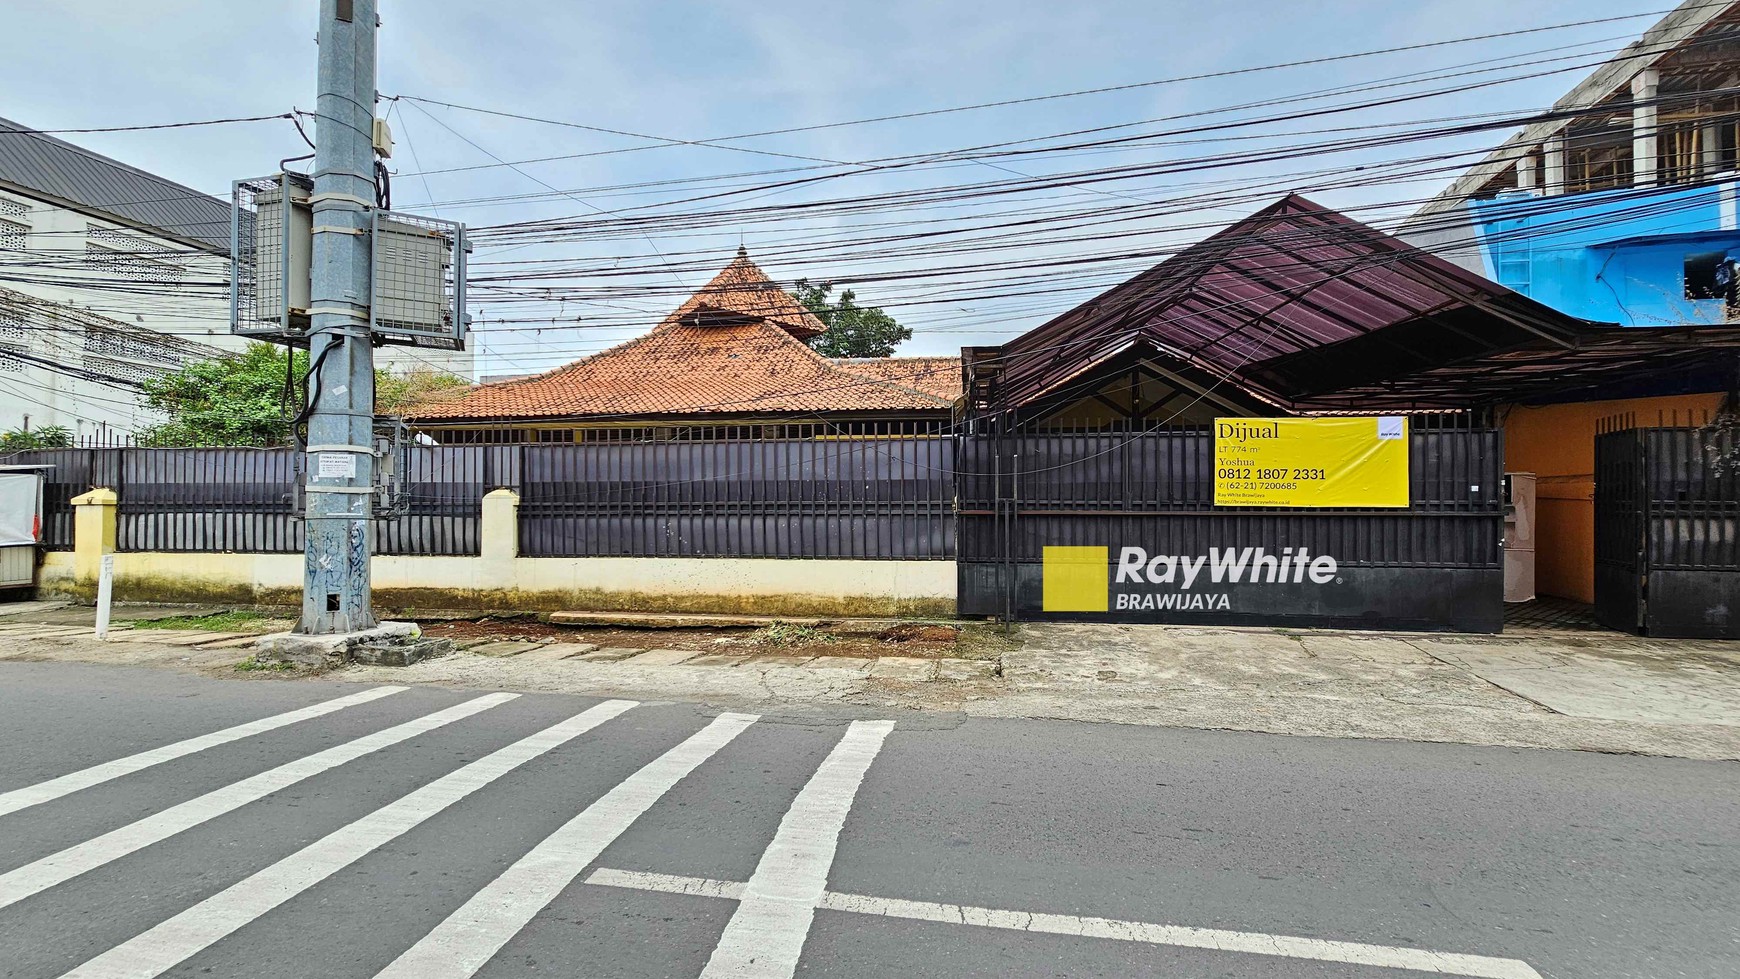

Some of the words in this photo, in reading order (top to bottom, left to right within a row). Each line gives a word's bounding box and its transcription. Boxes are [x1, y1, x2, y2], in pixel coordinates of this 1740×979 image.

[1218, 422, 1279, 442] Dijual
[1219, 457, 1255, 467] Yoshua
[1218, 468, 1251, 480] 0812
[1256, 468, 1288, 480] 1807
[1293, 468, 1326, 480] 2331
[1226, 482, 1257, 490] (62-21)
[1259, 482, 1297, 490] 7200685
